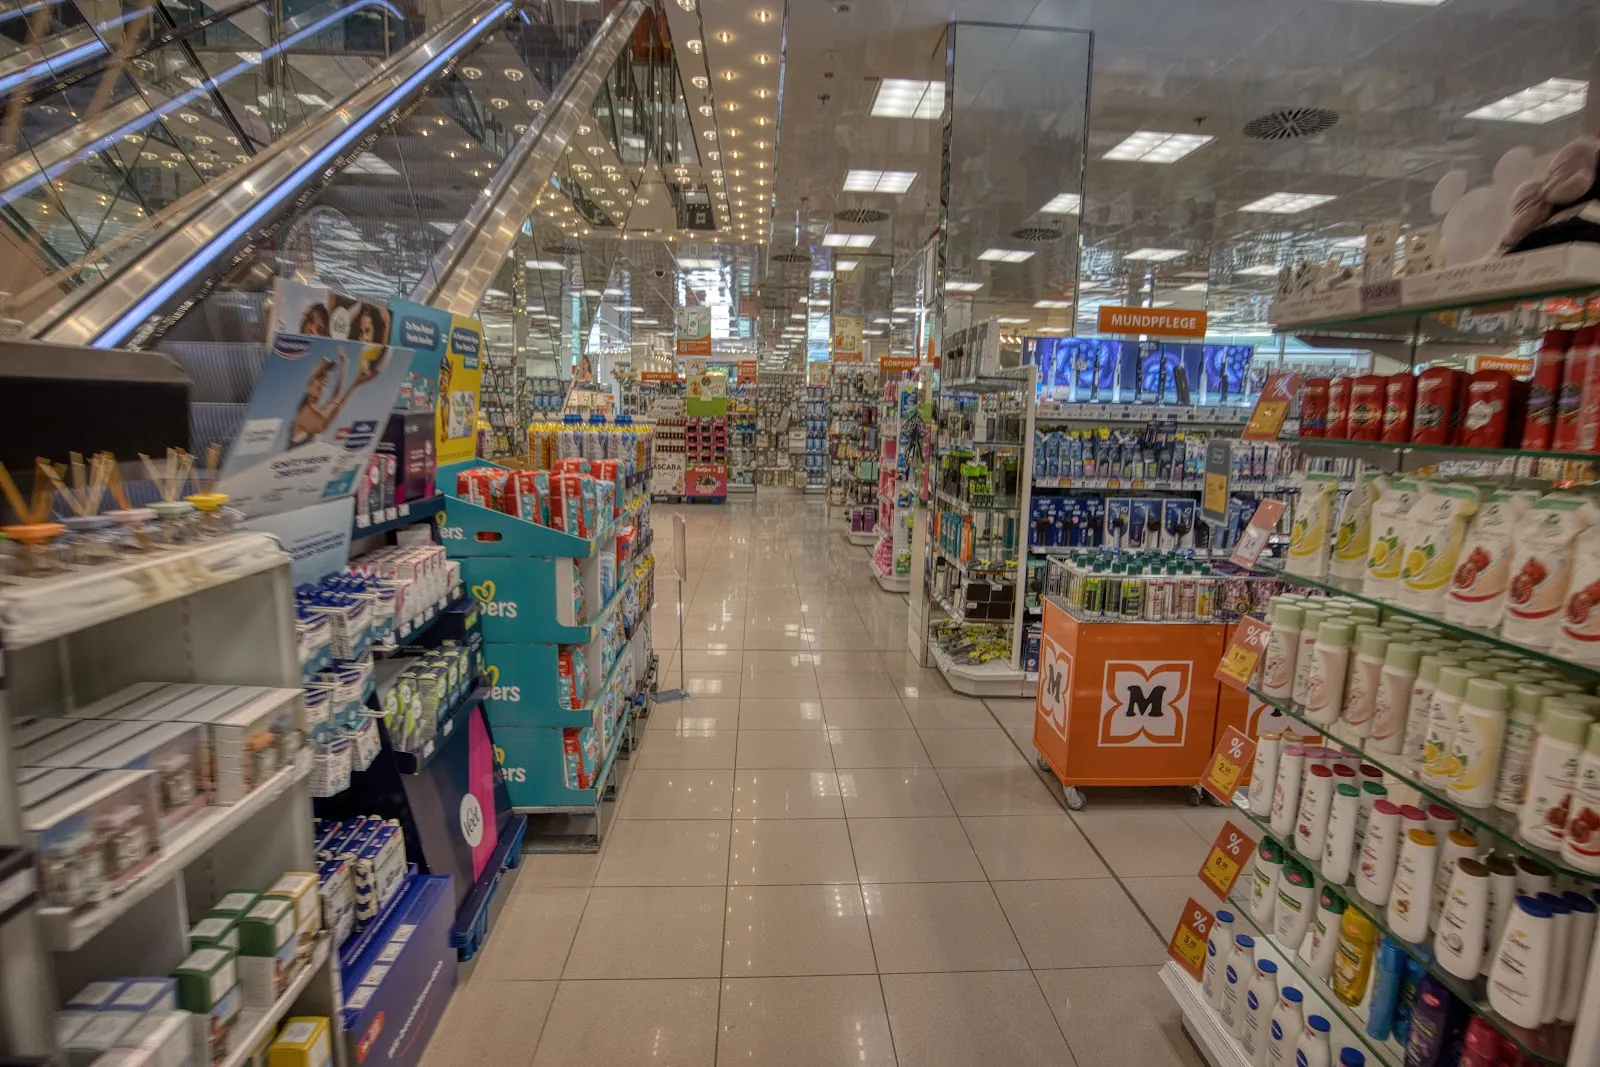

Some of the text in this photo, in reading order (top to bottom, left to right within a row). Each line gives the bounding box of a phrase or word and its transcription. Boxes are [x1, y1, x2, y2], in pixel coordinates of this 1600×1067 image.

[1111, 313, 1197, 330] MUNDPFLEGE
[1047, 664, 1062, 704] M
[1126, 685, 1167, 717] M
